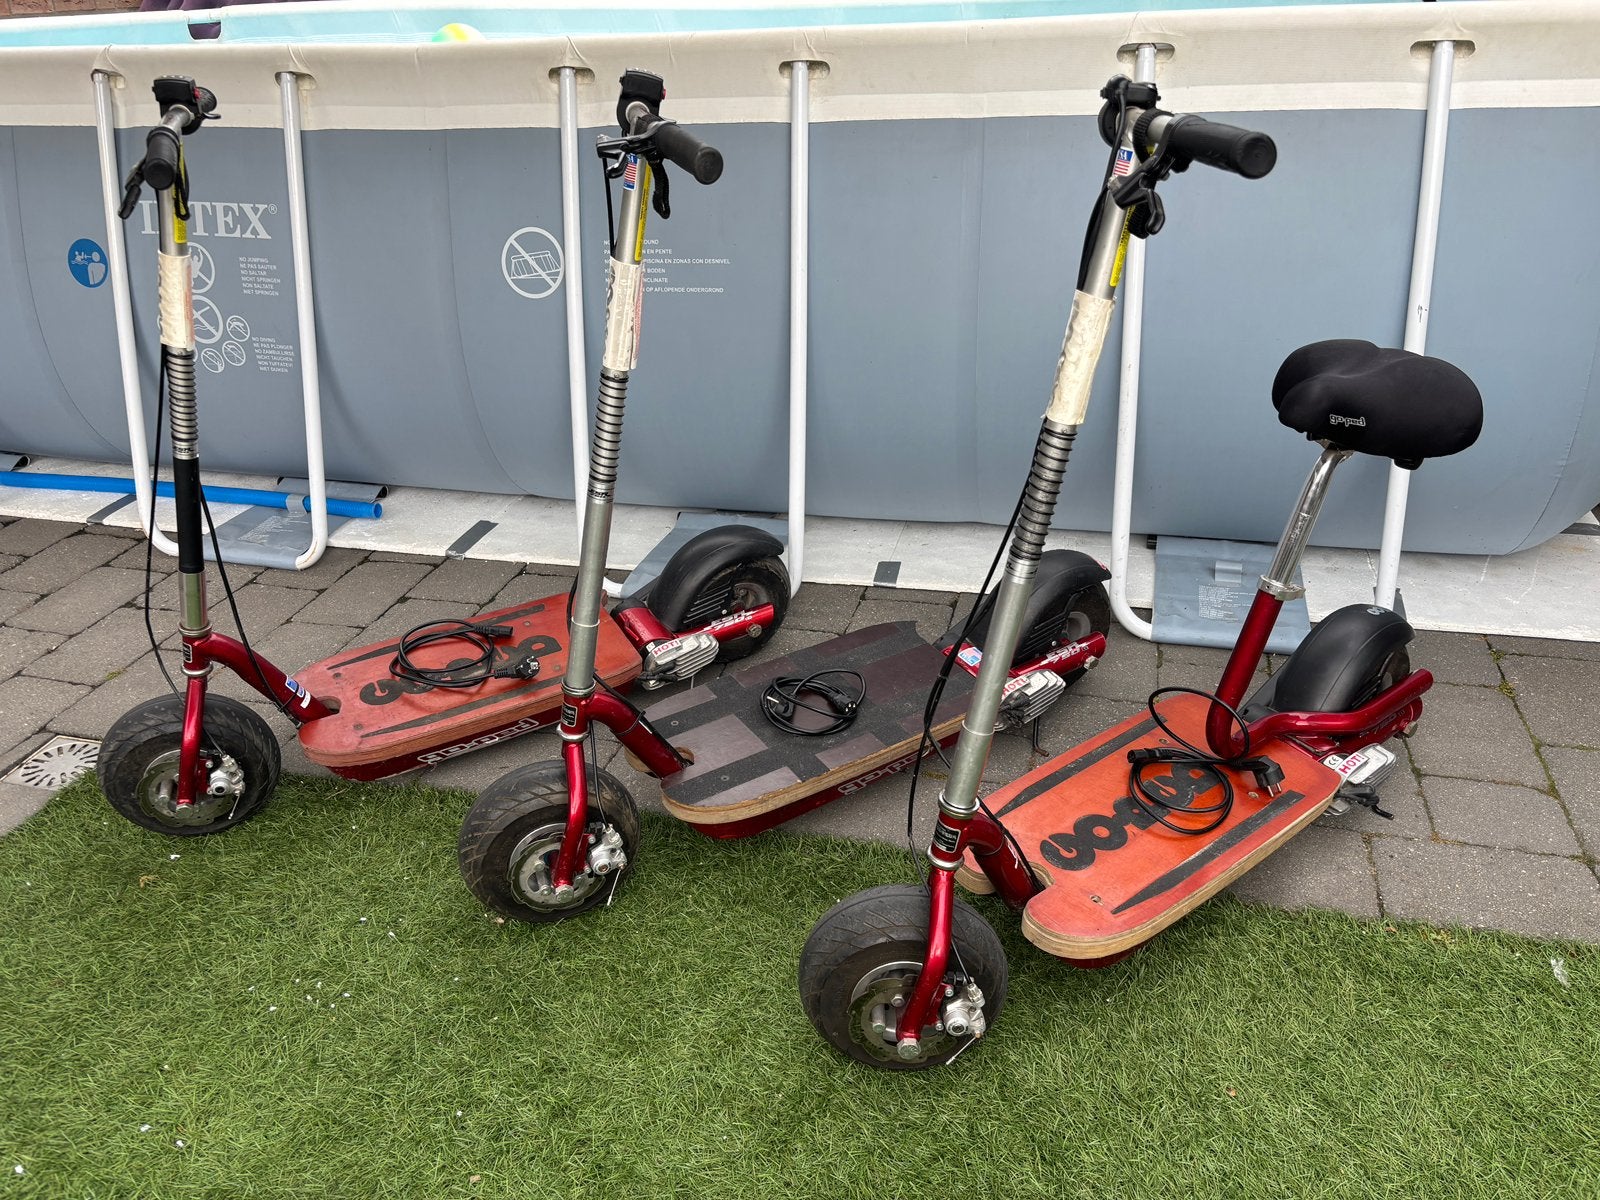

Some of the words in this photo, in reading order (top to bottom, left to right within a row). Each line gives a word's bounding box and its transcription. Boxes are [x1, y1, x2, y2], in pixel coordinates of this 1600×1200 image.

[1329, 414, 1366, 427] go-ped
[653, 640, 680, 656] HOT!
[1338, 753, 1366, 775] HOT!
